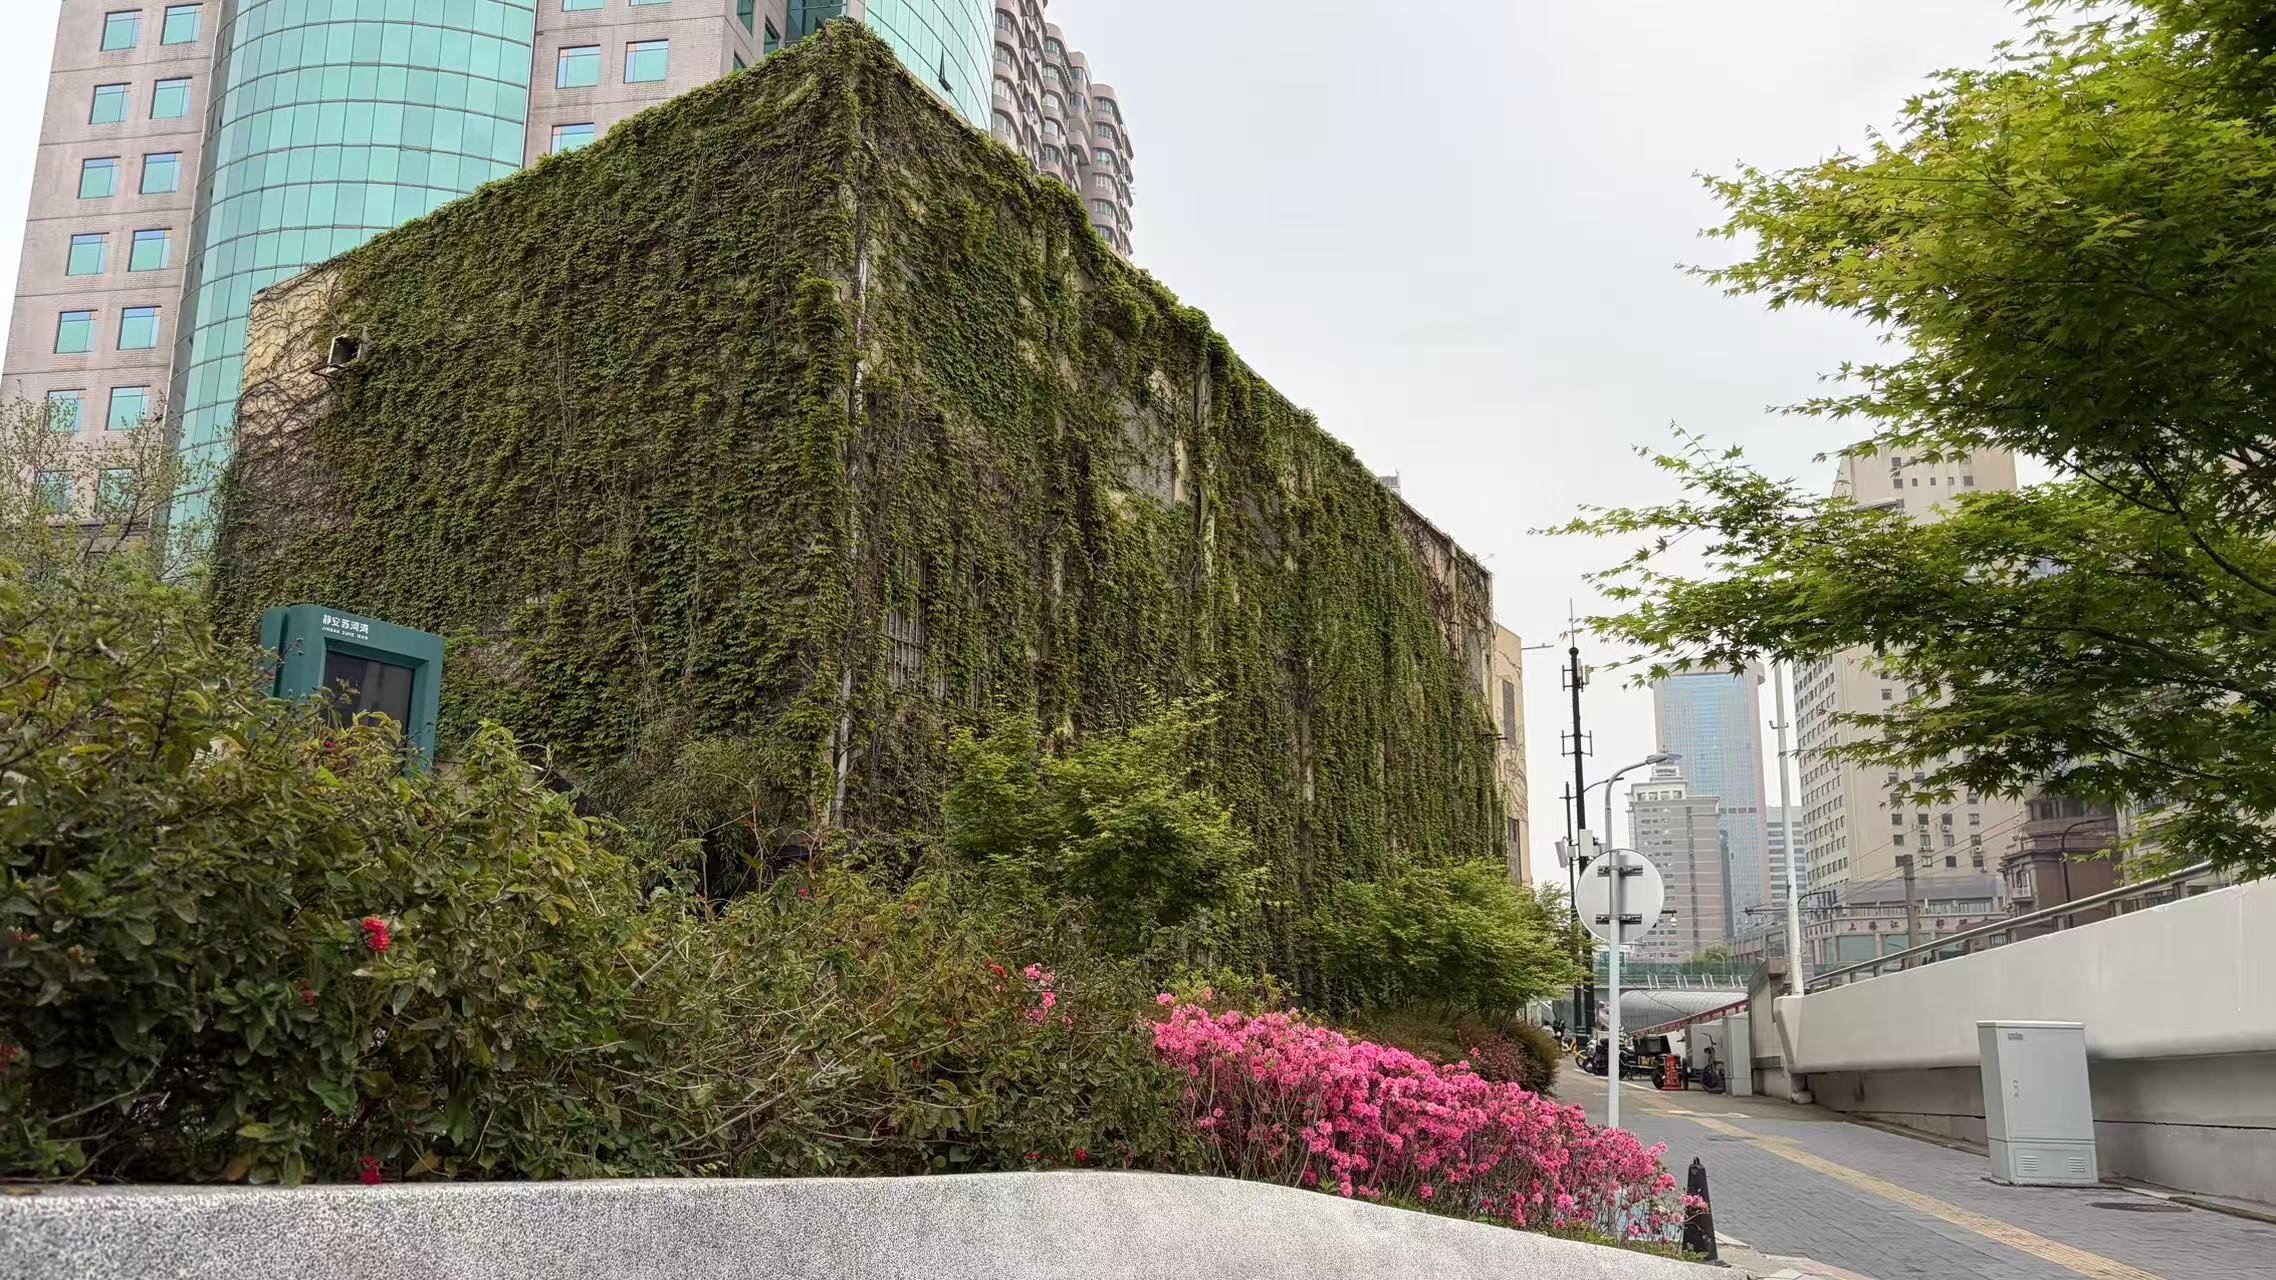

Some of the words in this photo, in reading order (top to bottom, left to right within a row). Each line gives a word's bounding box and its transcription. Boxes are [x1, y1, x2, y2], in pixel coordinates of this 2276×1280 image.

[322, 614, 369, 634] 静安苏河湾
